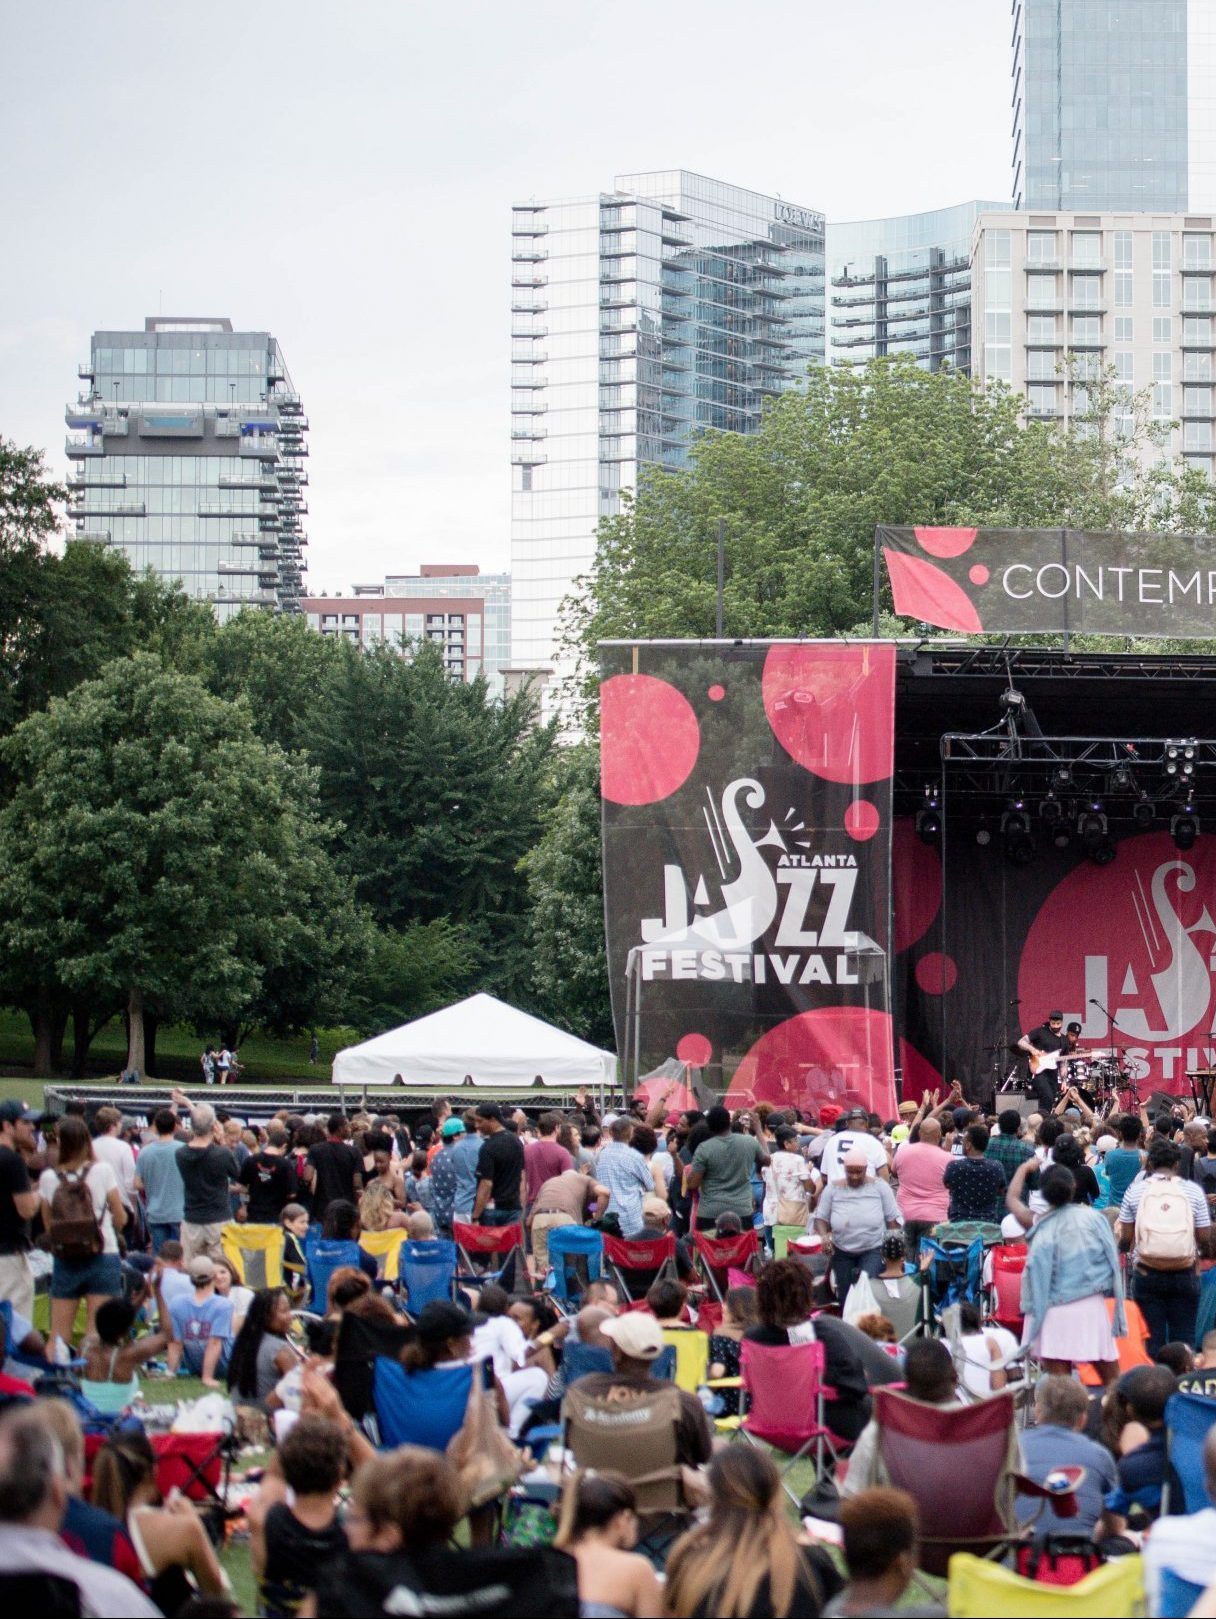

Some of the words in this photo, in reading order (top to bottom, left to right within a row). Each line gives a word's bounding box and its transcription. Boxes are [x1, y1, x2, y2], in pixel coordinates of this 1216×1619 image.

[778, 854, 857, 868] ATLANTA
[641, 864, 859, 950] JAZZ
[641, 949, 859, 985] FESTIVAL
